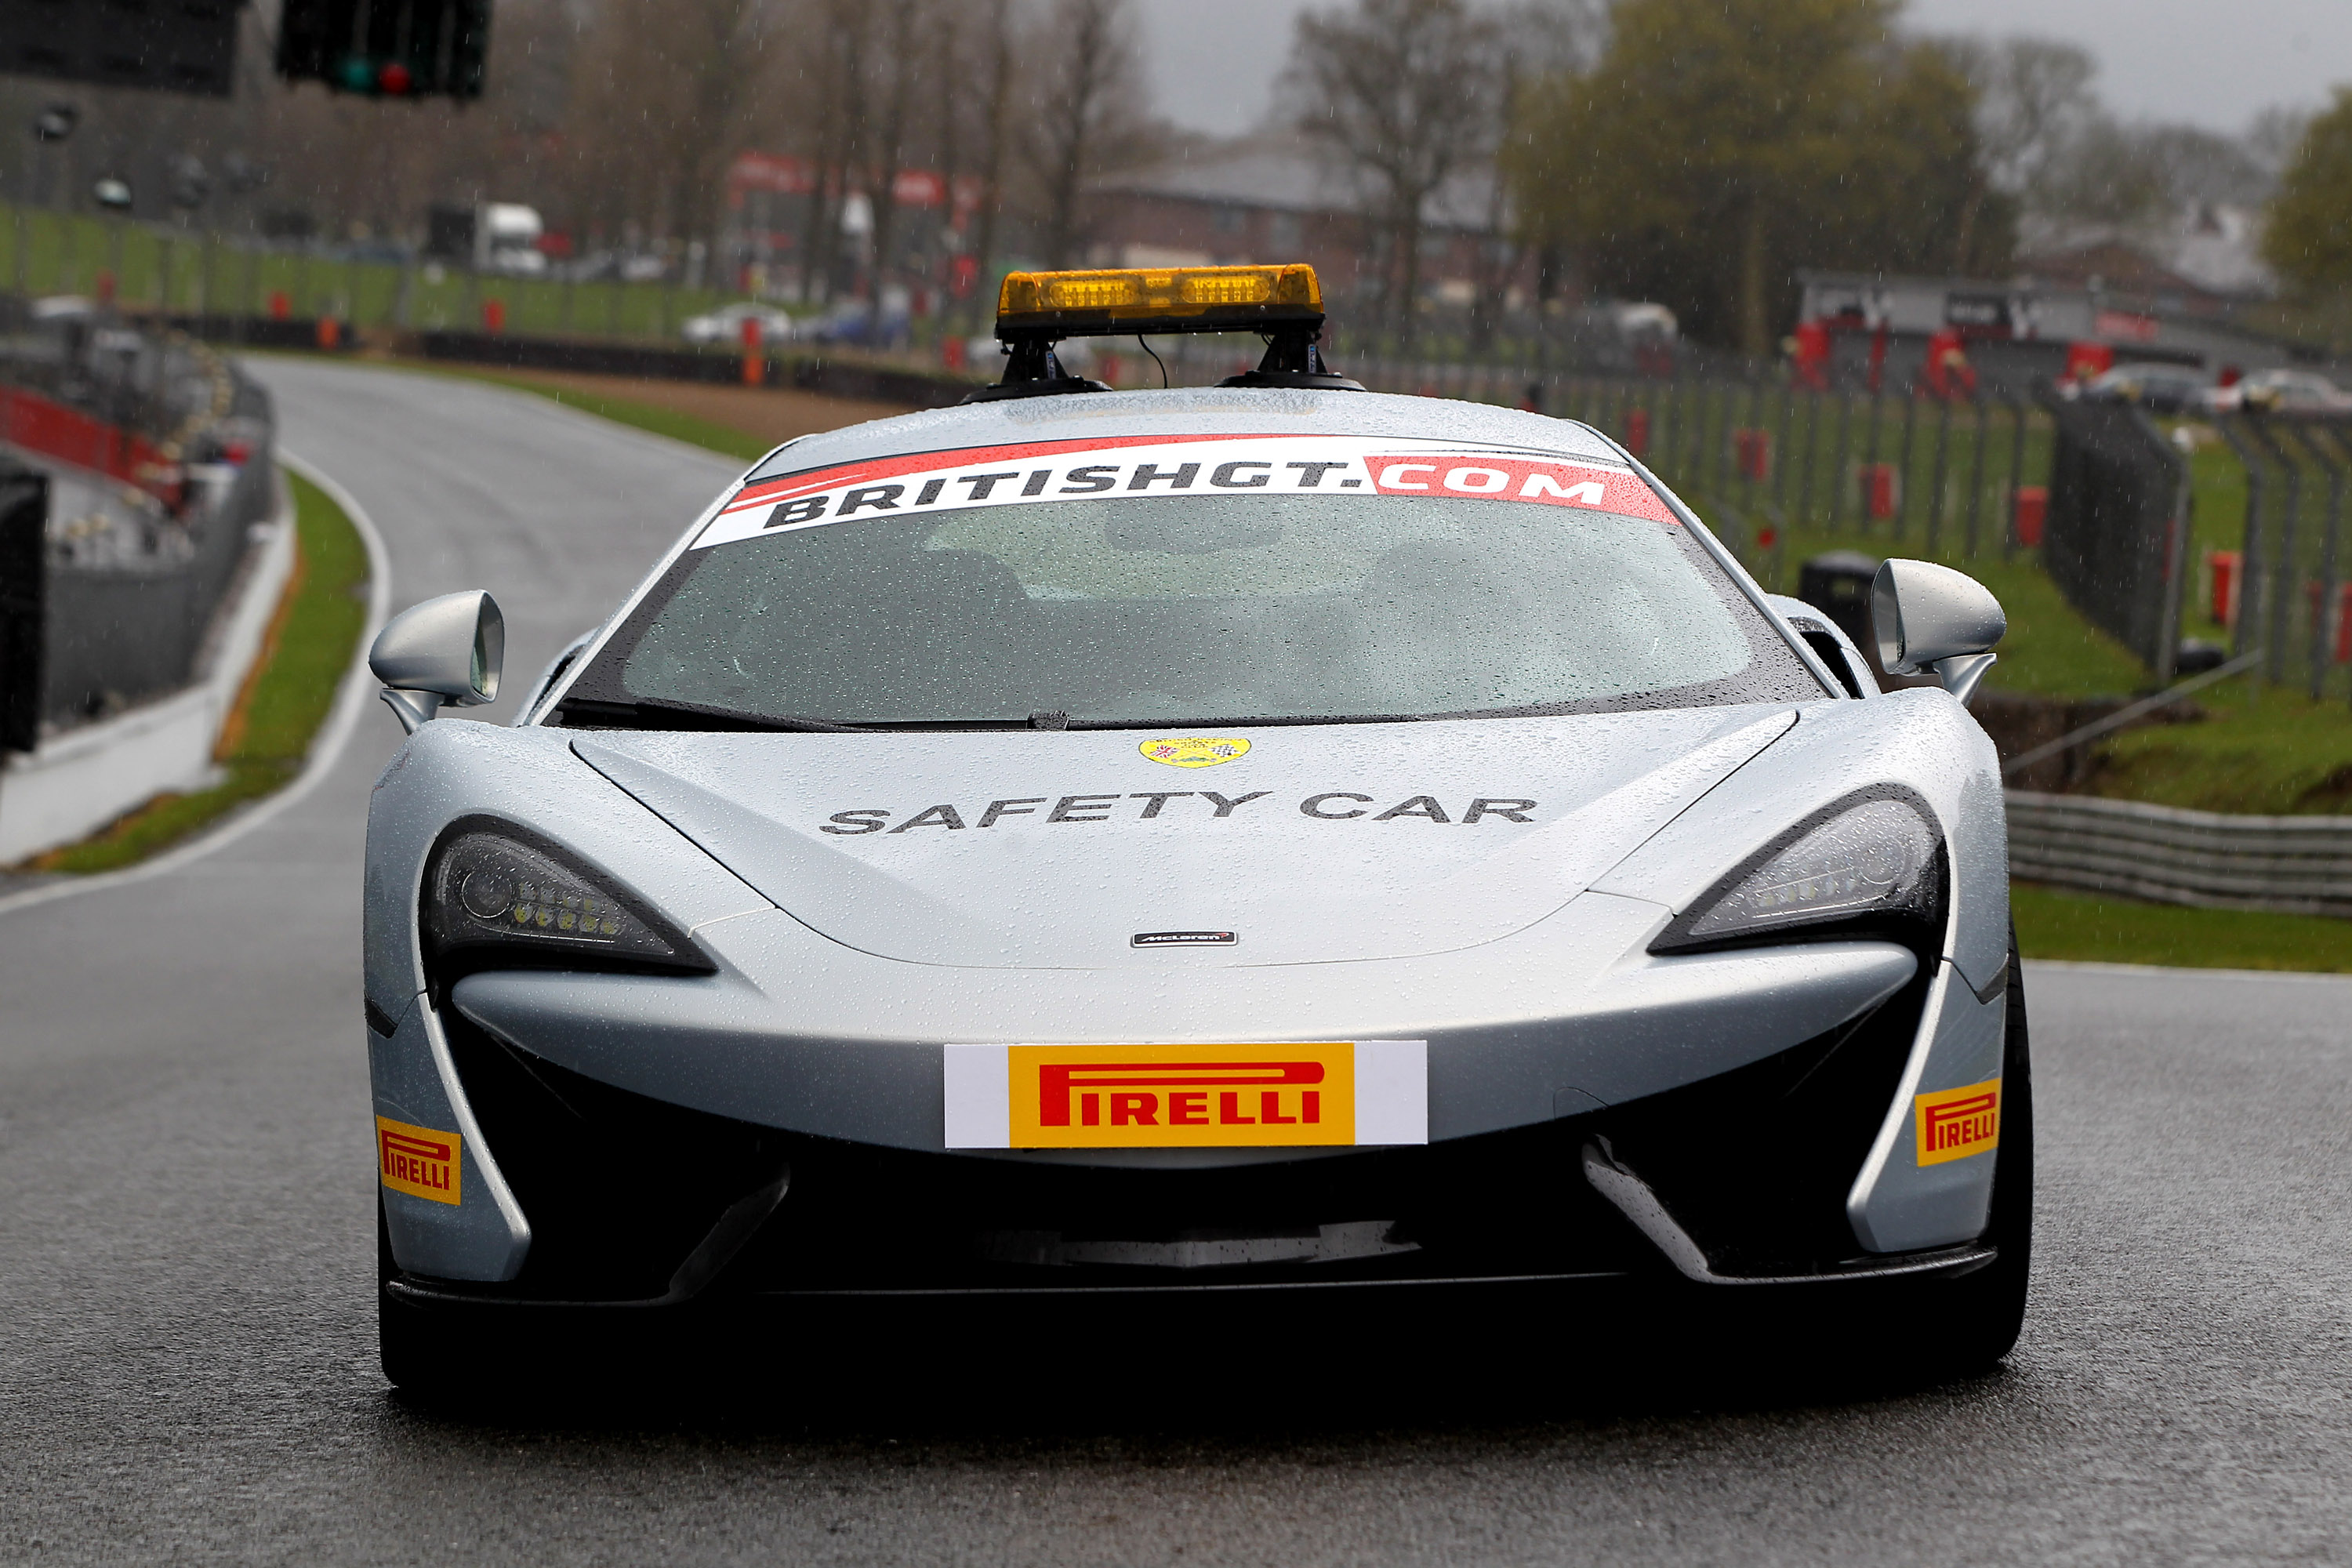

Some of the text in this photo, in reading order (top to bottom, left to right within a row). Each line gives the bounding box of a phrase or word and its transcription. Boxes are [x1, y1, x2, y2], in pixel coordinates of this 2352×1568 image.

[763, 462, 1606, 529] BRITISHGT.COM
[818, 791, 1537, 836] SAFETY CAR
[1039, 1062, 1325, 1127] PIRELLI
[1926, 1091, 1996, 1152] PIRELLI
[381, 1129, 451, 1190] PIRELLI
